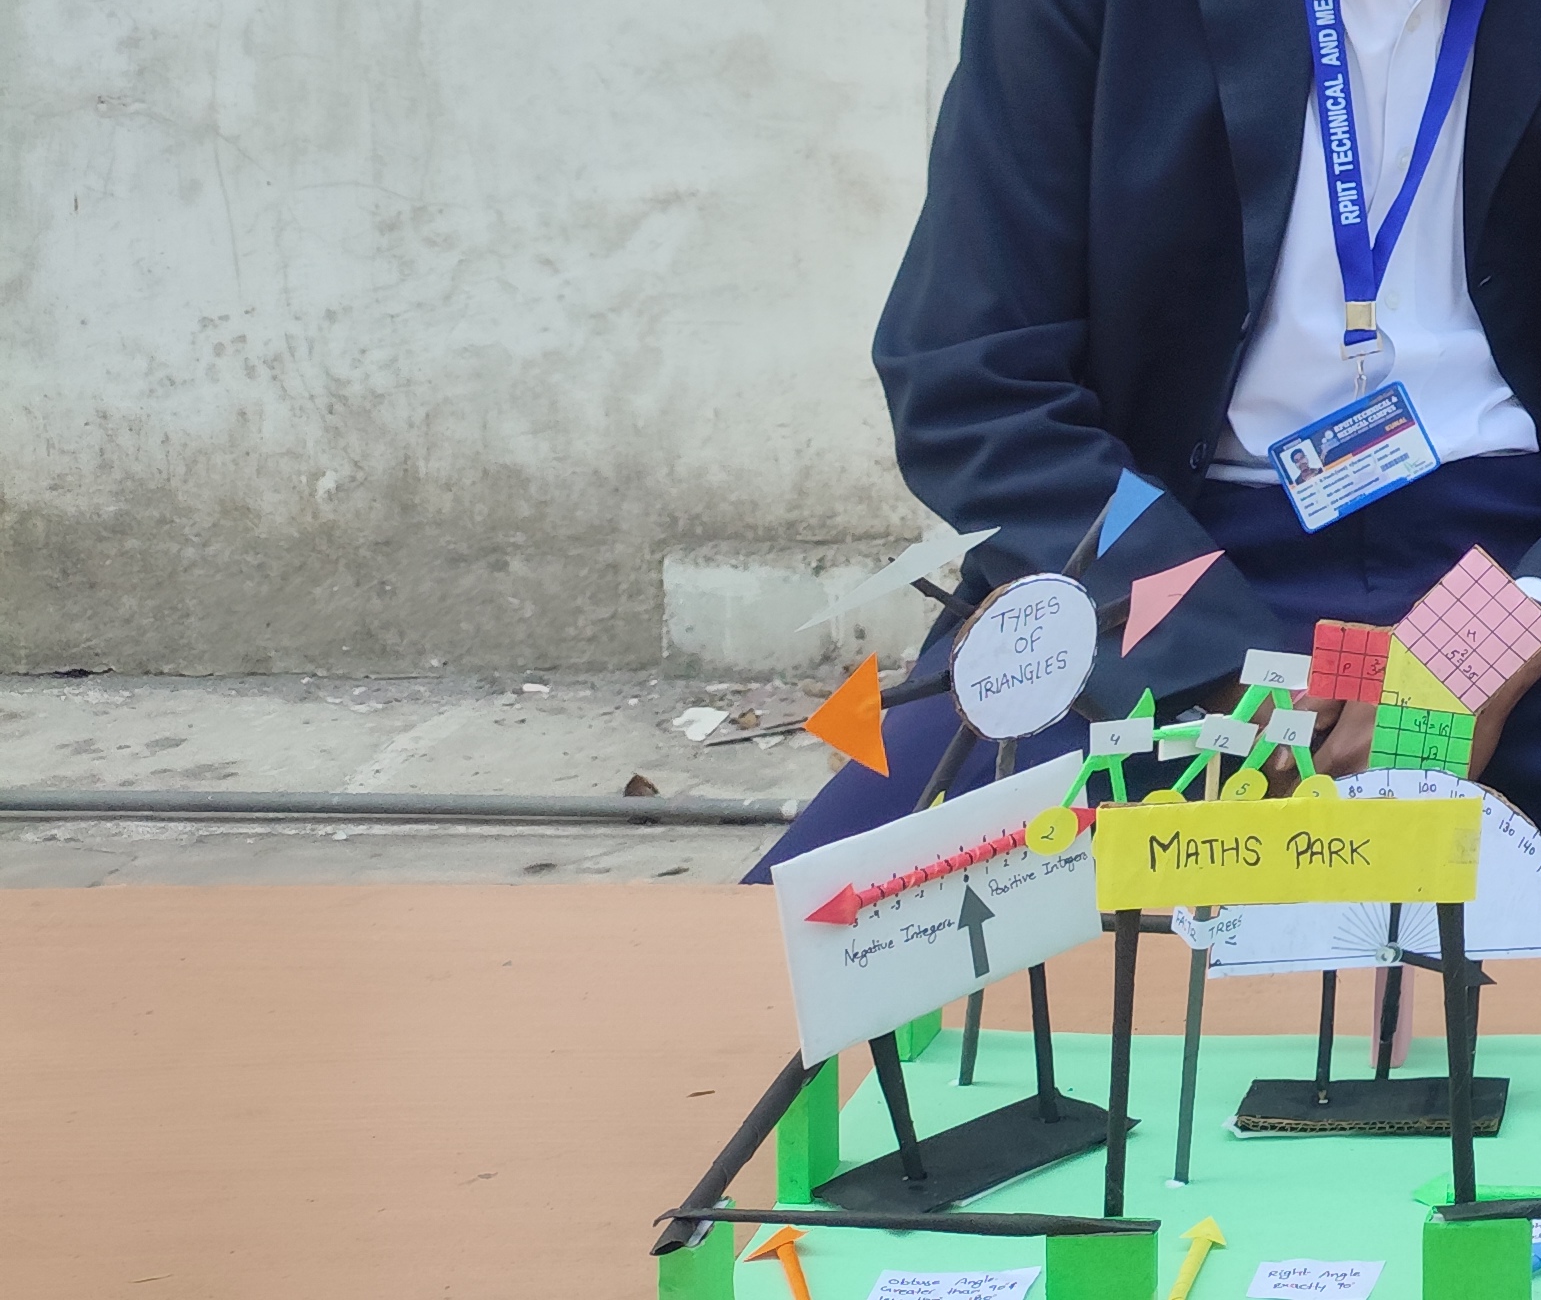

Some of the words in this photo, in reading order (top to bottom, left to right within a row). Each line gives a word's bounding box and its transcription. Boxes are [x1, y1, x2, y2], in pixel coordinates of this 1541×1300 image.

[1320, 27, 1342, 68] AND
[1325, 73, 1355, 176] TECHNICAL
[1339, 180, 1361, 226] RPIIT
[991, 596, 1061, 633] TYPES
[1014, 626, 1043, 654] OF
[970, 650, 1068, 702] TRIANGLES
[1263, 670, 1285, 685] 120
[1110, 733, 1121, 746] 4
[1213, 735, 1230, 749] 12
[1282, 727, 1297, 742] 10
[1235, 782, 1250, 797] 5
[1348, 785, 1364, 798] 80
[1418, 781, 1437, 794] 100
[1040, 825, 1055, 841] 2
[1498, 819, 1515, 837] 130
[1148, 830, 1263, 873] MATHS
[1285, 831, 1371, 870] PARK
[1518, 836, 1536, 856] 140
[988, 871, 1037, 898] Positive
[844, 937, 896, 969] Negative
[888, 1277, 941, 1287] Obtuse
[1317, 1268, 1361, 1282] Angle
[880, 1285, 937, 1296] Greater
[946, 1286, 981, 1296] than
